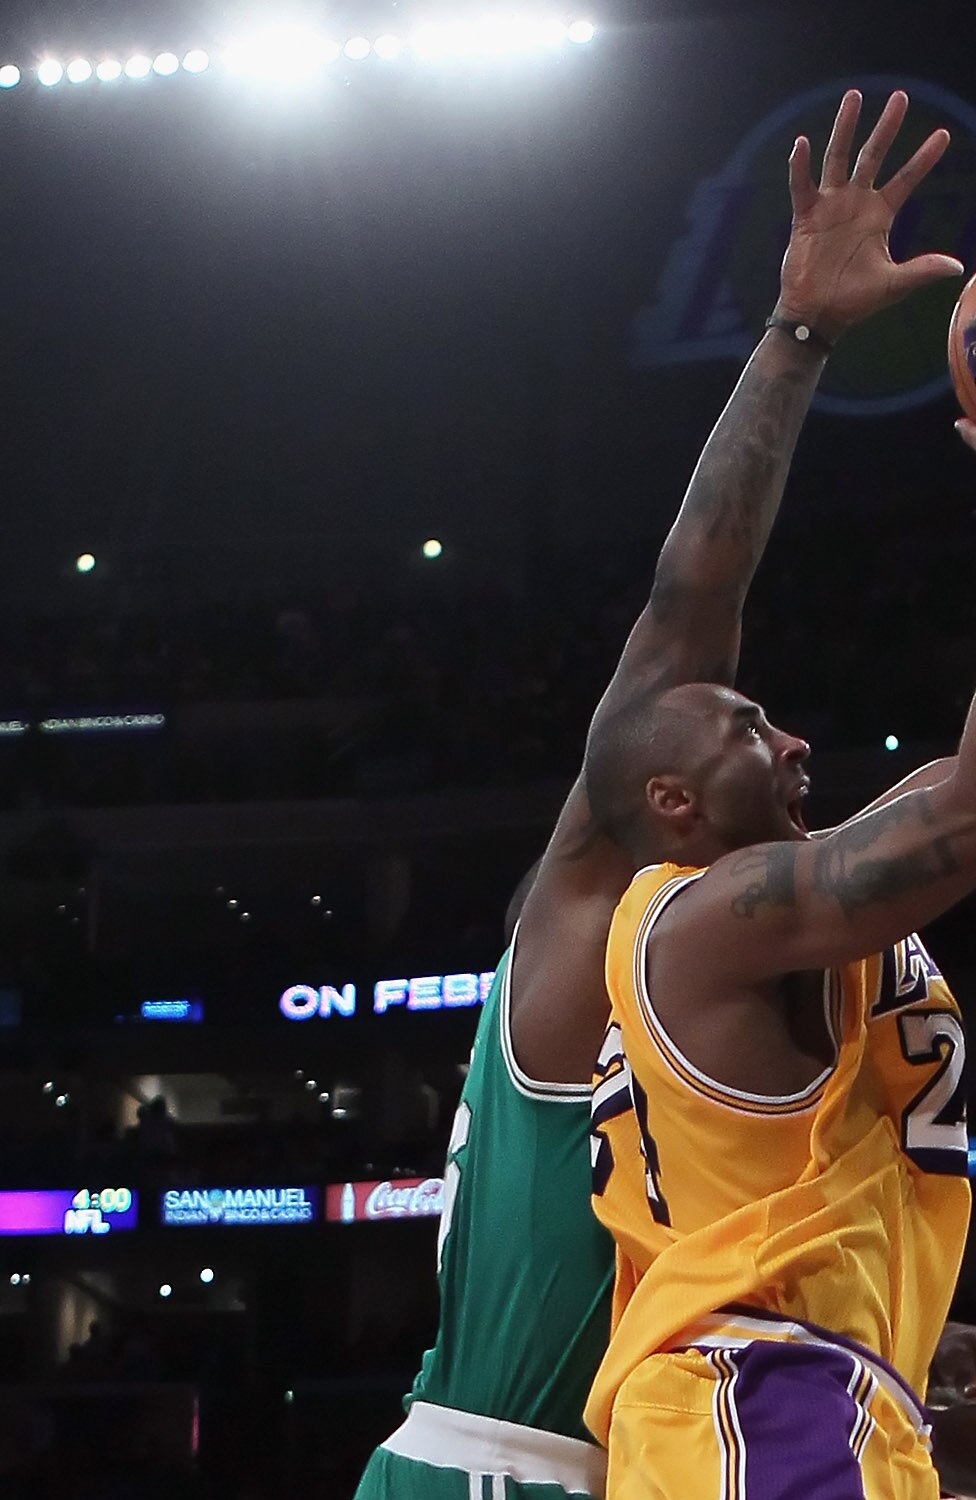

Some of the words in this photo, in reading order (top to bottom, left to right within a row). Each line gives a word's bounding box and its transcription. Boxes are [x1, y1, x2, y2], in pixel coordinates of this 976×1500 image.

[279, 984, 356, 1021] ON
[72, 1187, 132, 1213] 4:00
[165, 1189, 208, 1208] SAN
[222, 1187, 311, 1208] MANUEL
[64, 1209, 110, 1234] NFL
